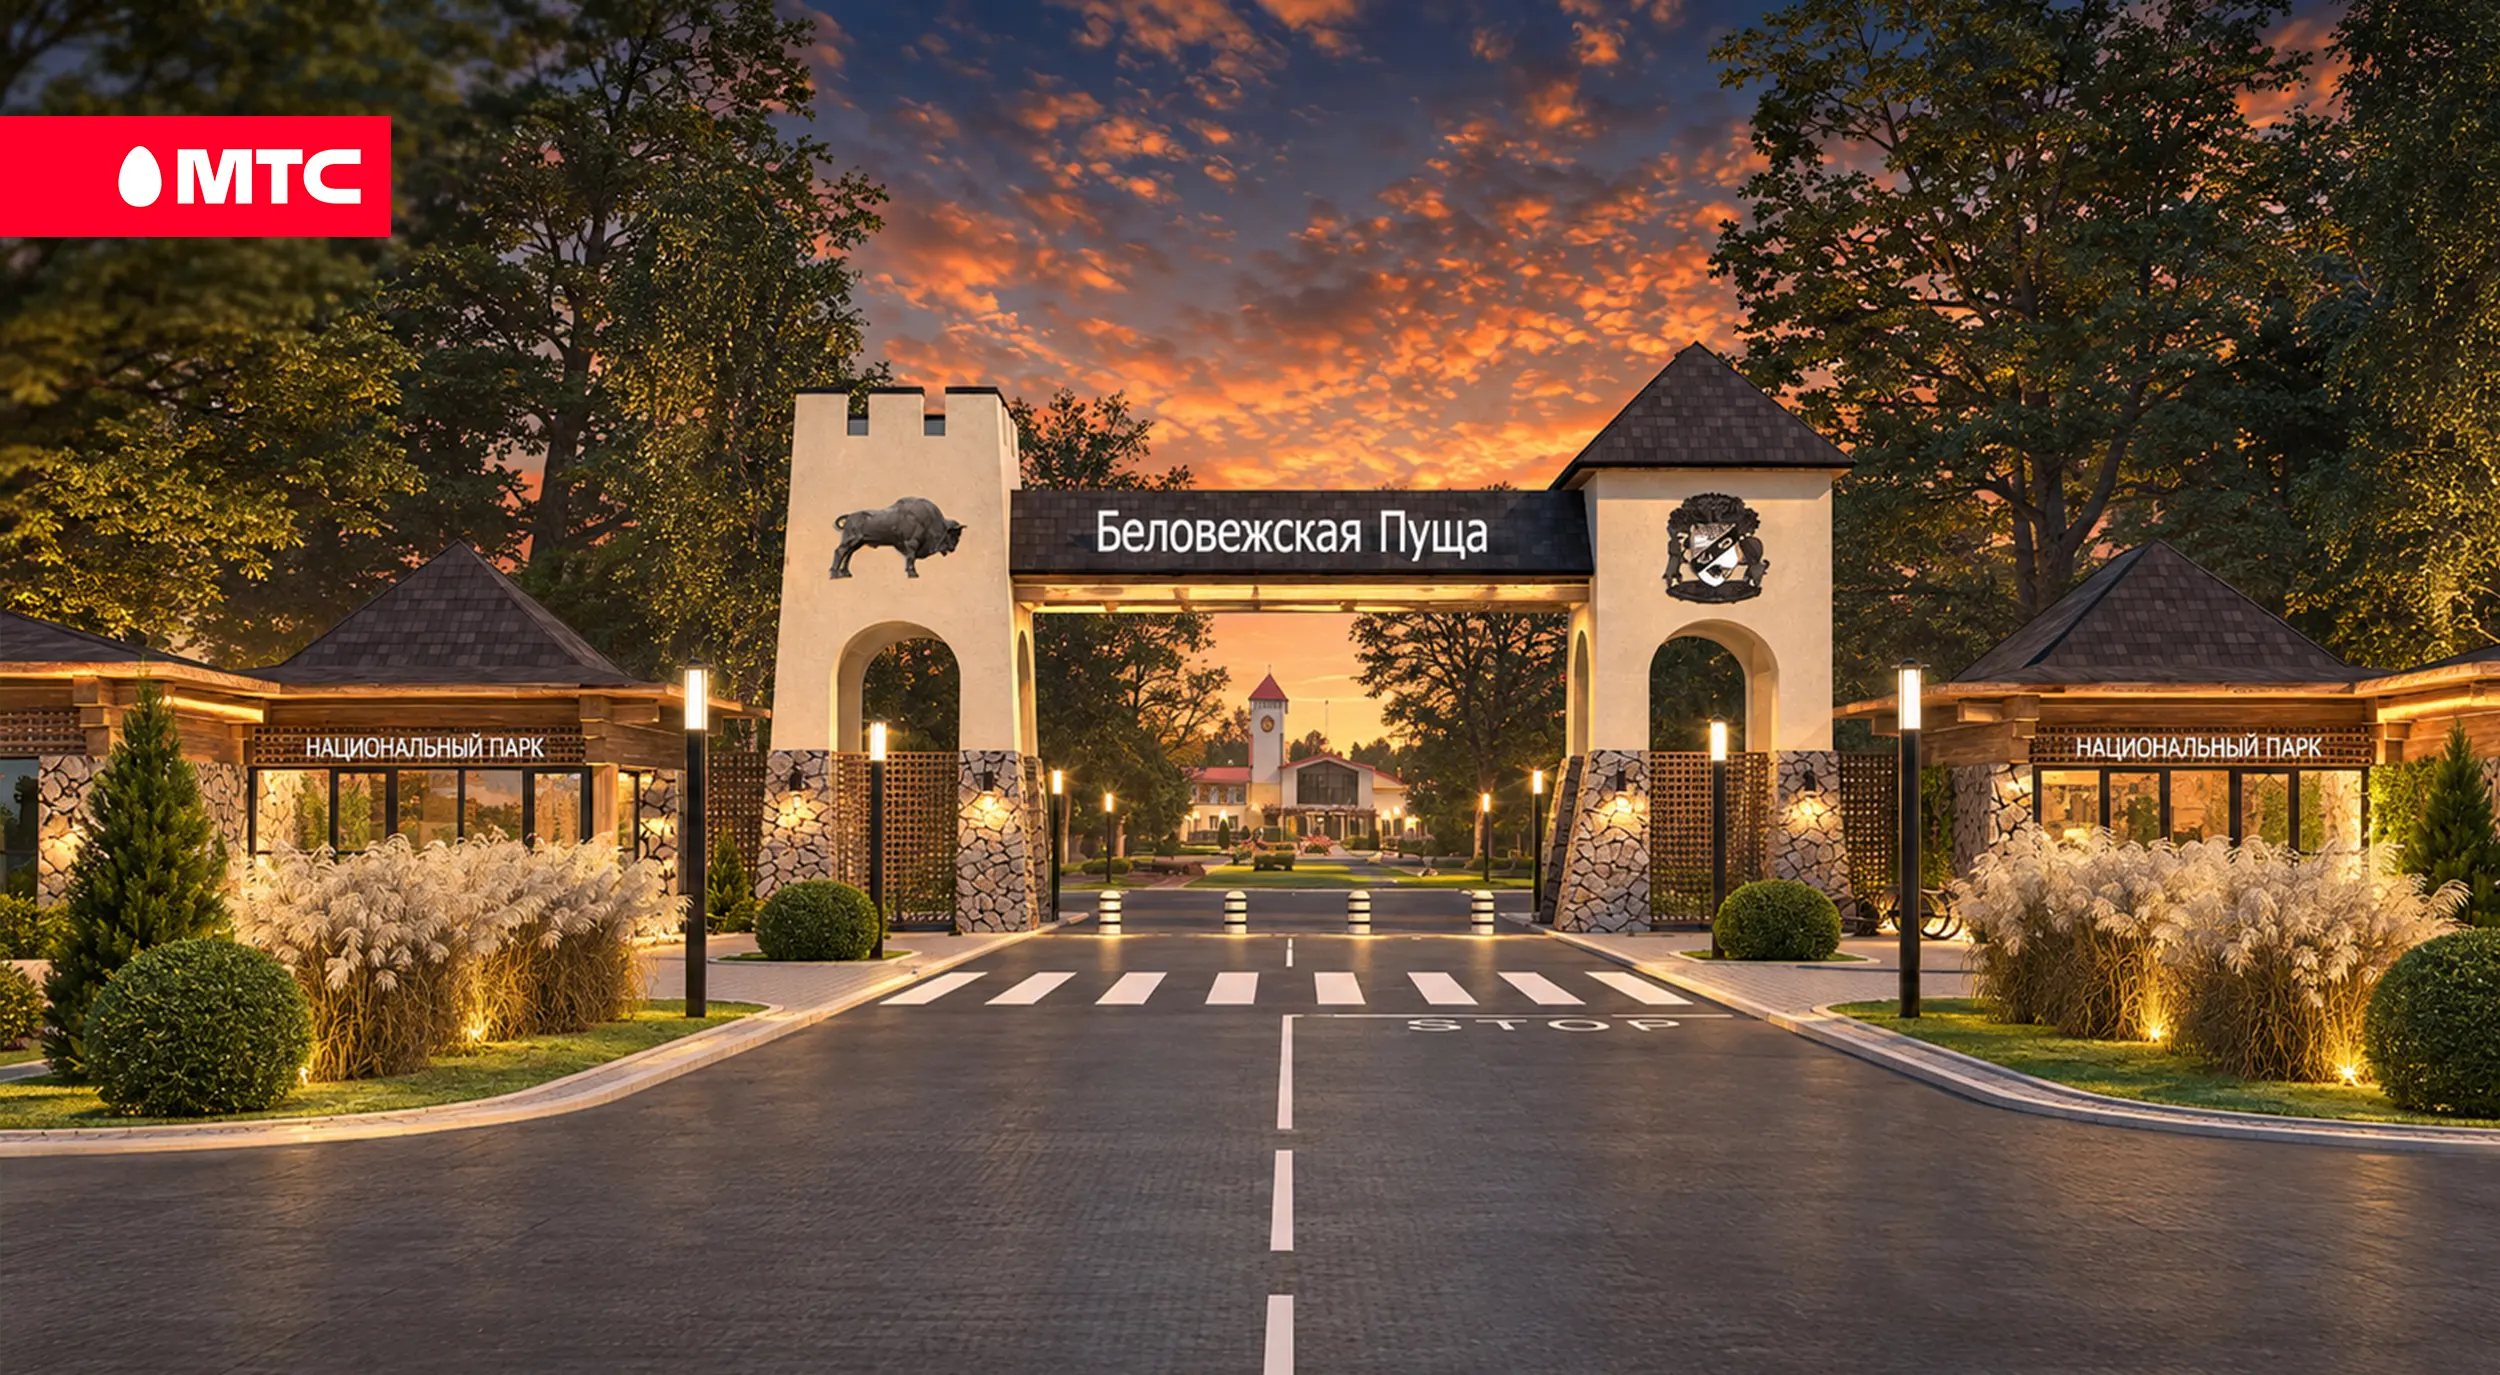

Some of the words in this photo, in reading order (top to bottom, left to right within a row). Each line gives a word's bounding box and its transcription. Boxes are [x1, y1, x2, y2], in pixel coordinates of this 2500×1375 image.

[1097, 510, 1361, 553] Беловежская
[1380, 510, 1488, 562] Пуща
[306, 733, 483, 761] НАЦИОНАЛЬНЫЙ
[490, 737, 545, 758] ПАРК
[2076, 733, 2259, 761] НАЦИОНАЛЬНЫЙ
[2266, 737, 2322, 758] ПАРК
[1408, 1019, 1680, 1032] STOP
